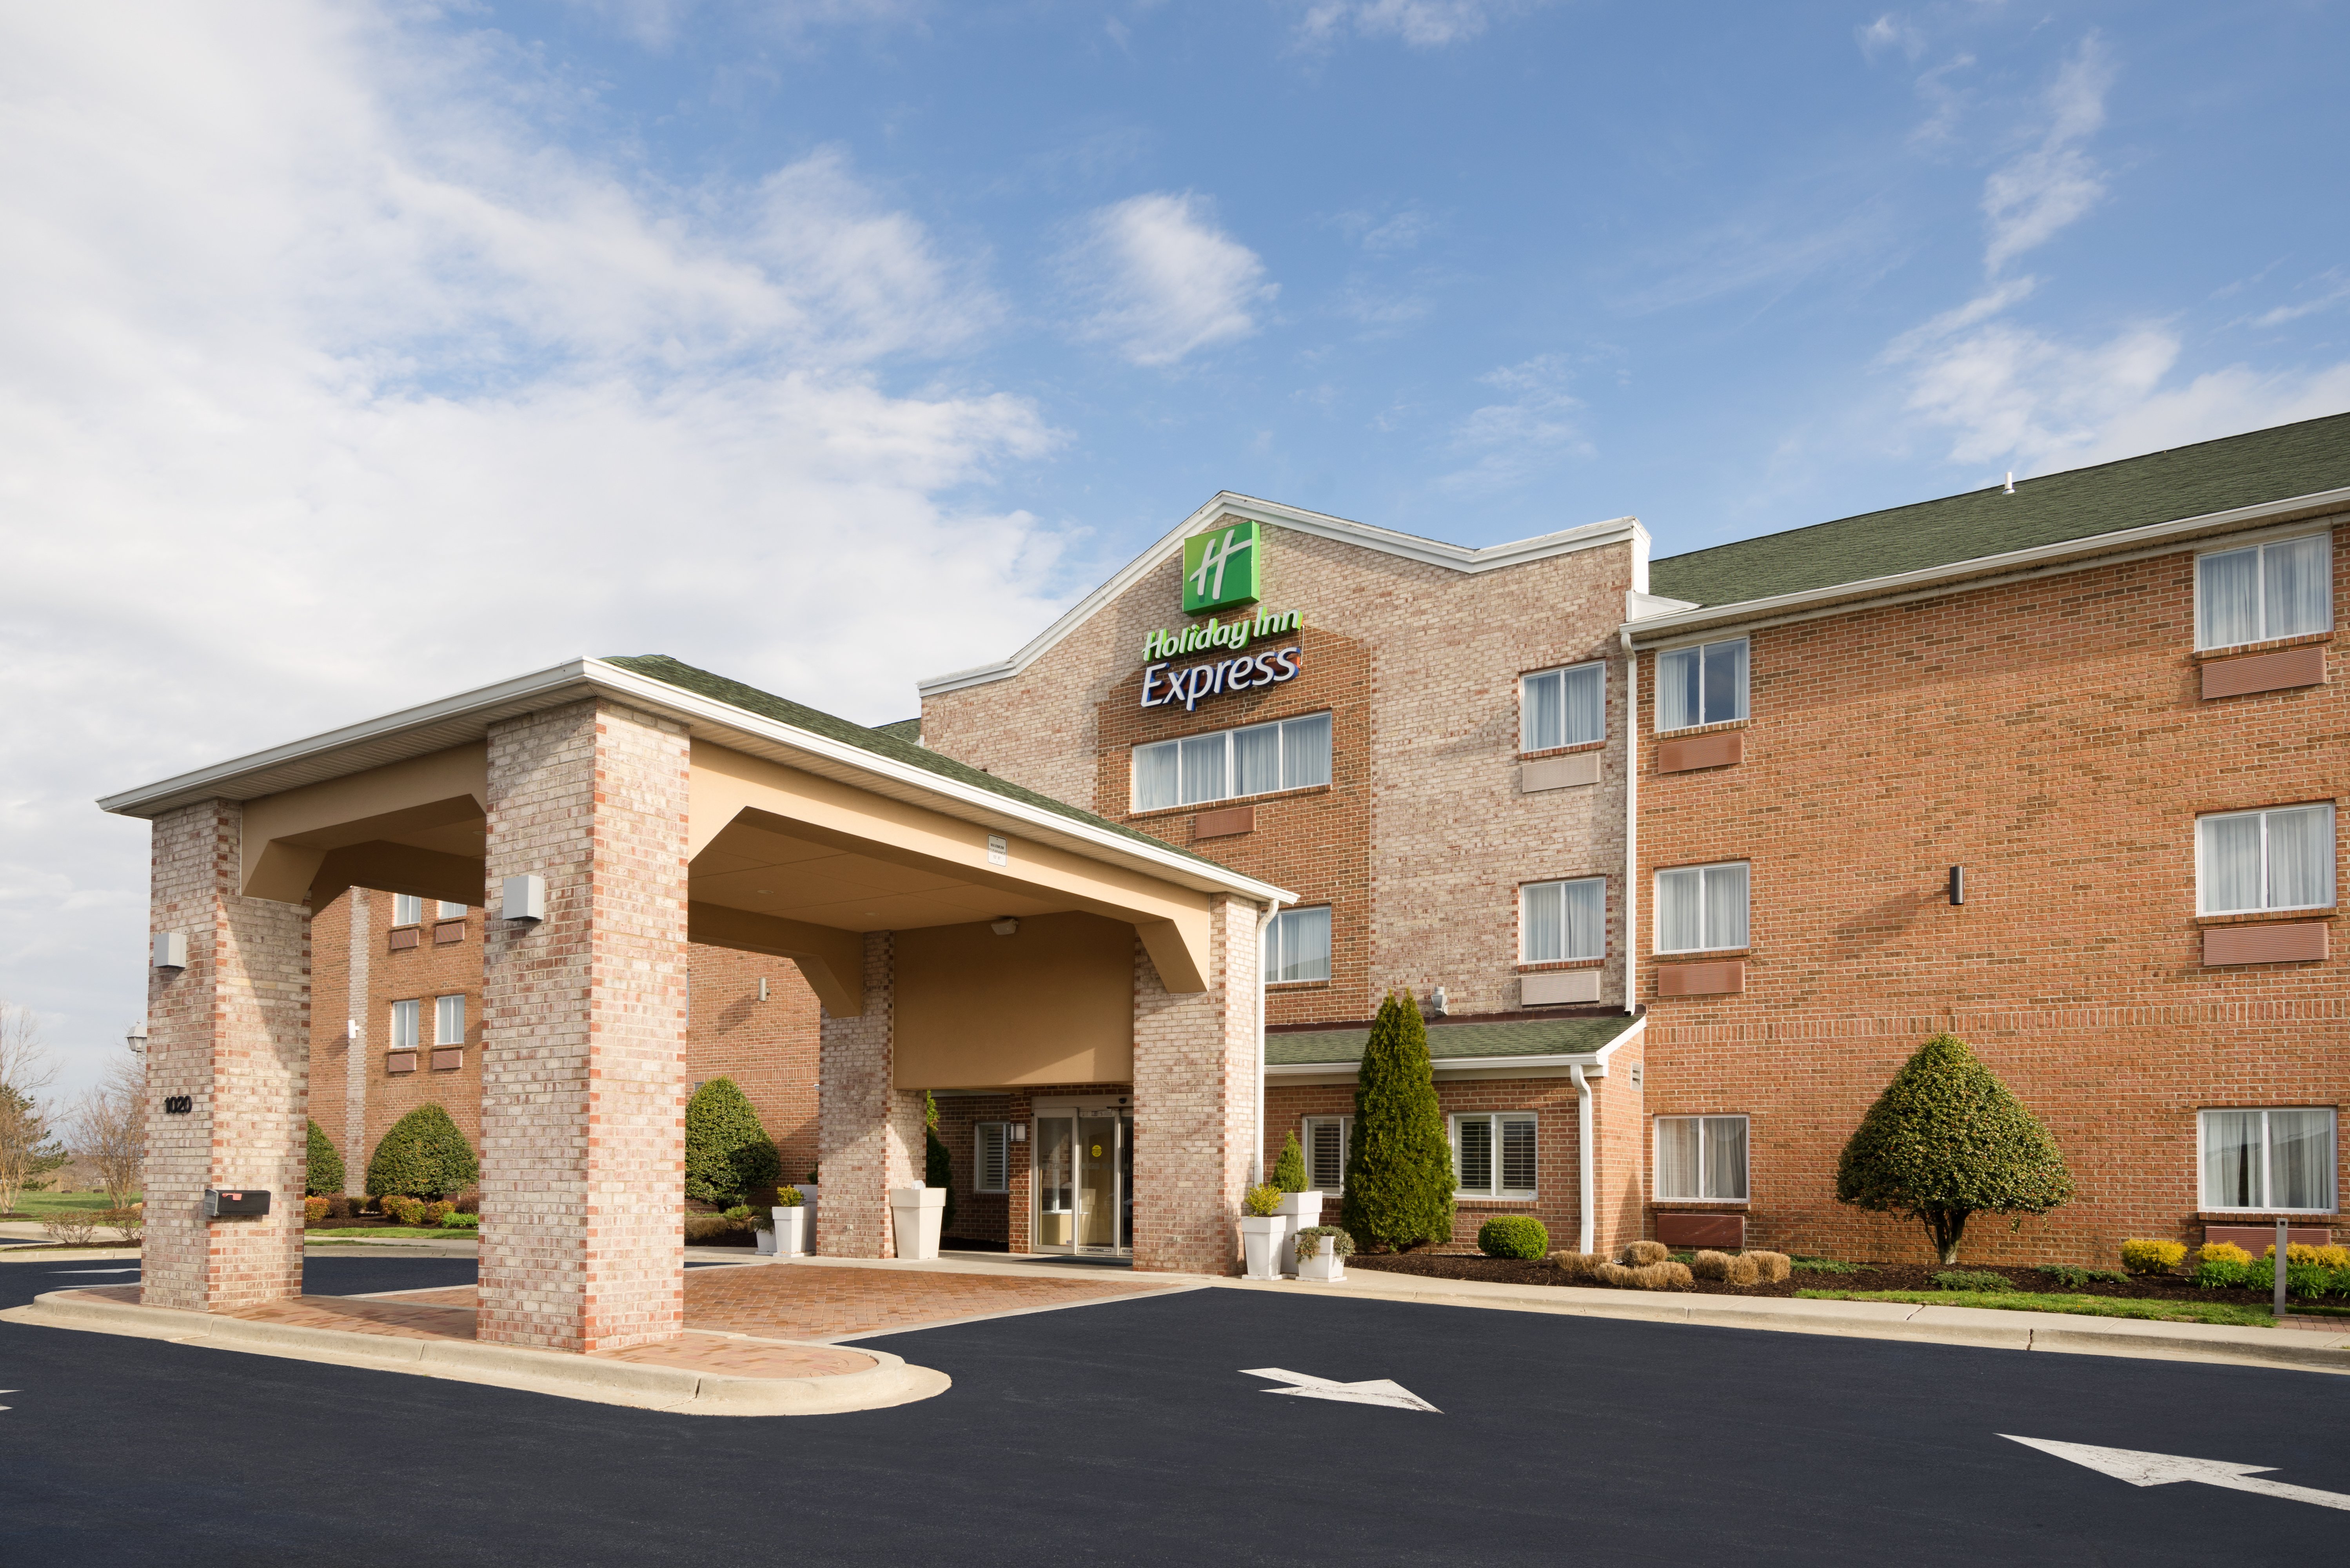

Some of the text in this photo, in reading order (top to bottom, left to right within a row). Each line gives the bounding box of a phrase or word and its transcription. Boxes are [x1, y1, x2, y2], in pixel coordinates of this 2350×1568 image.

[1189, 529, 1252, 600] H
[1141, 606, 1303, 662] Holiday Inn
[1140, 647, 1301, 711] Express
[164, 1096, 192, 1114] 1020
